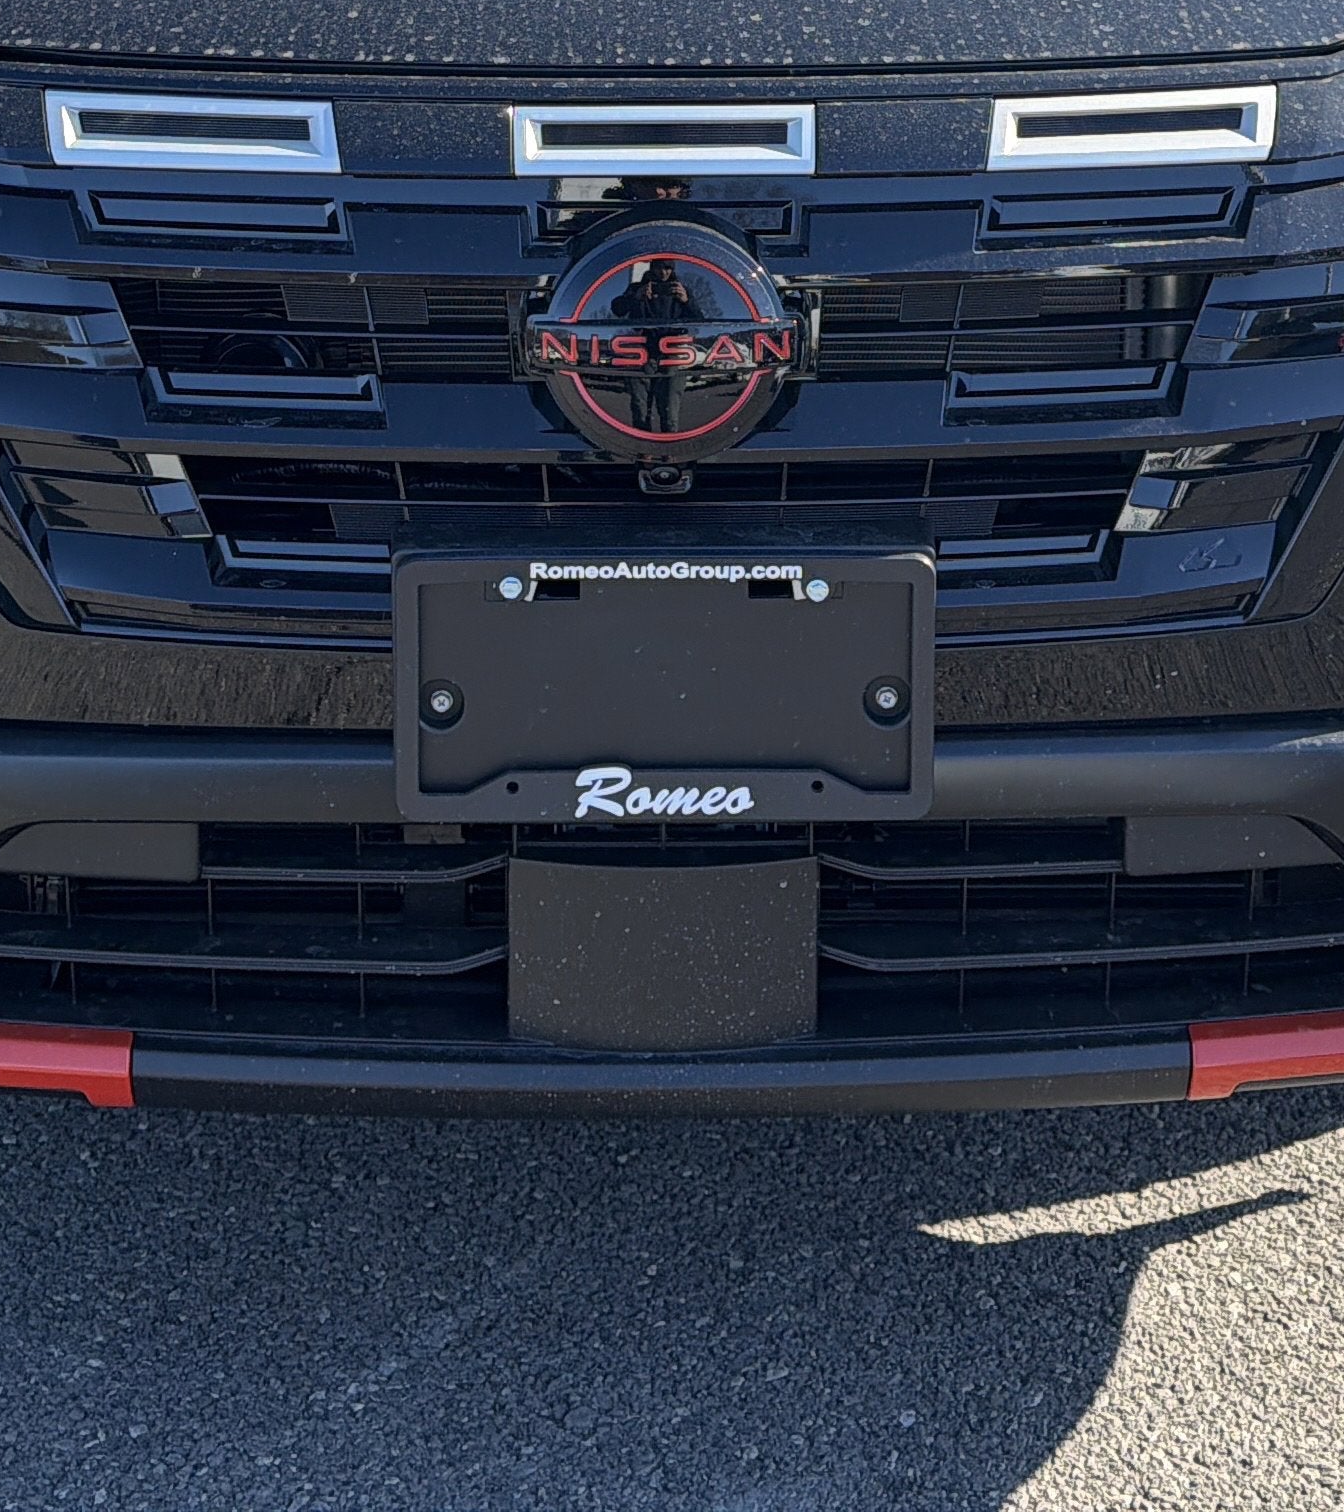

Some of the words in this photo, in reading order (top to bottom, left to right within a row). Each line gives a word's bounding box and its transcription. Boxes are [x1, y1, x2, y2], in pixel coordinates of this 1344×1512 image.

[540, 330, 792, 367] NISSAN
[529, 561, 803, 582] RomeoAutoGroup.com
[574, 765, 755, 820] Romeo
